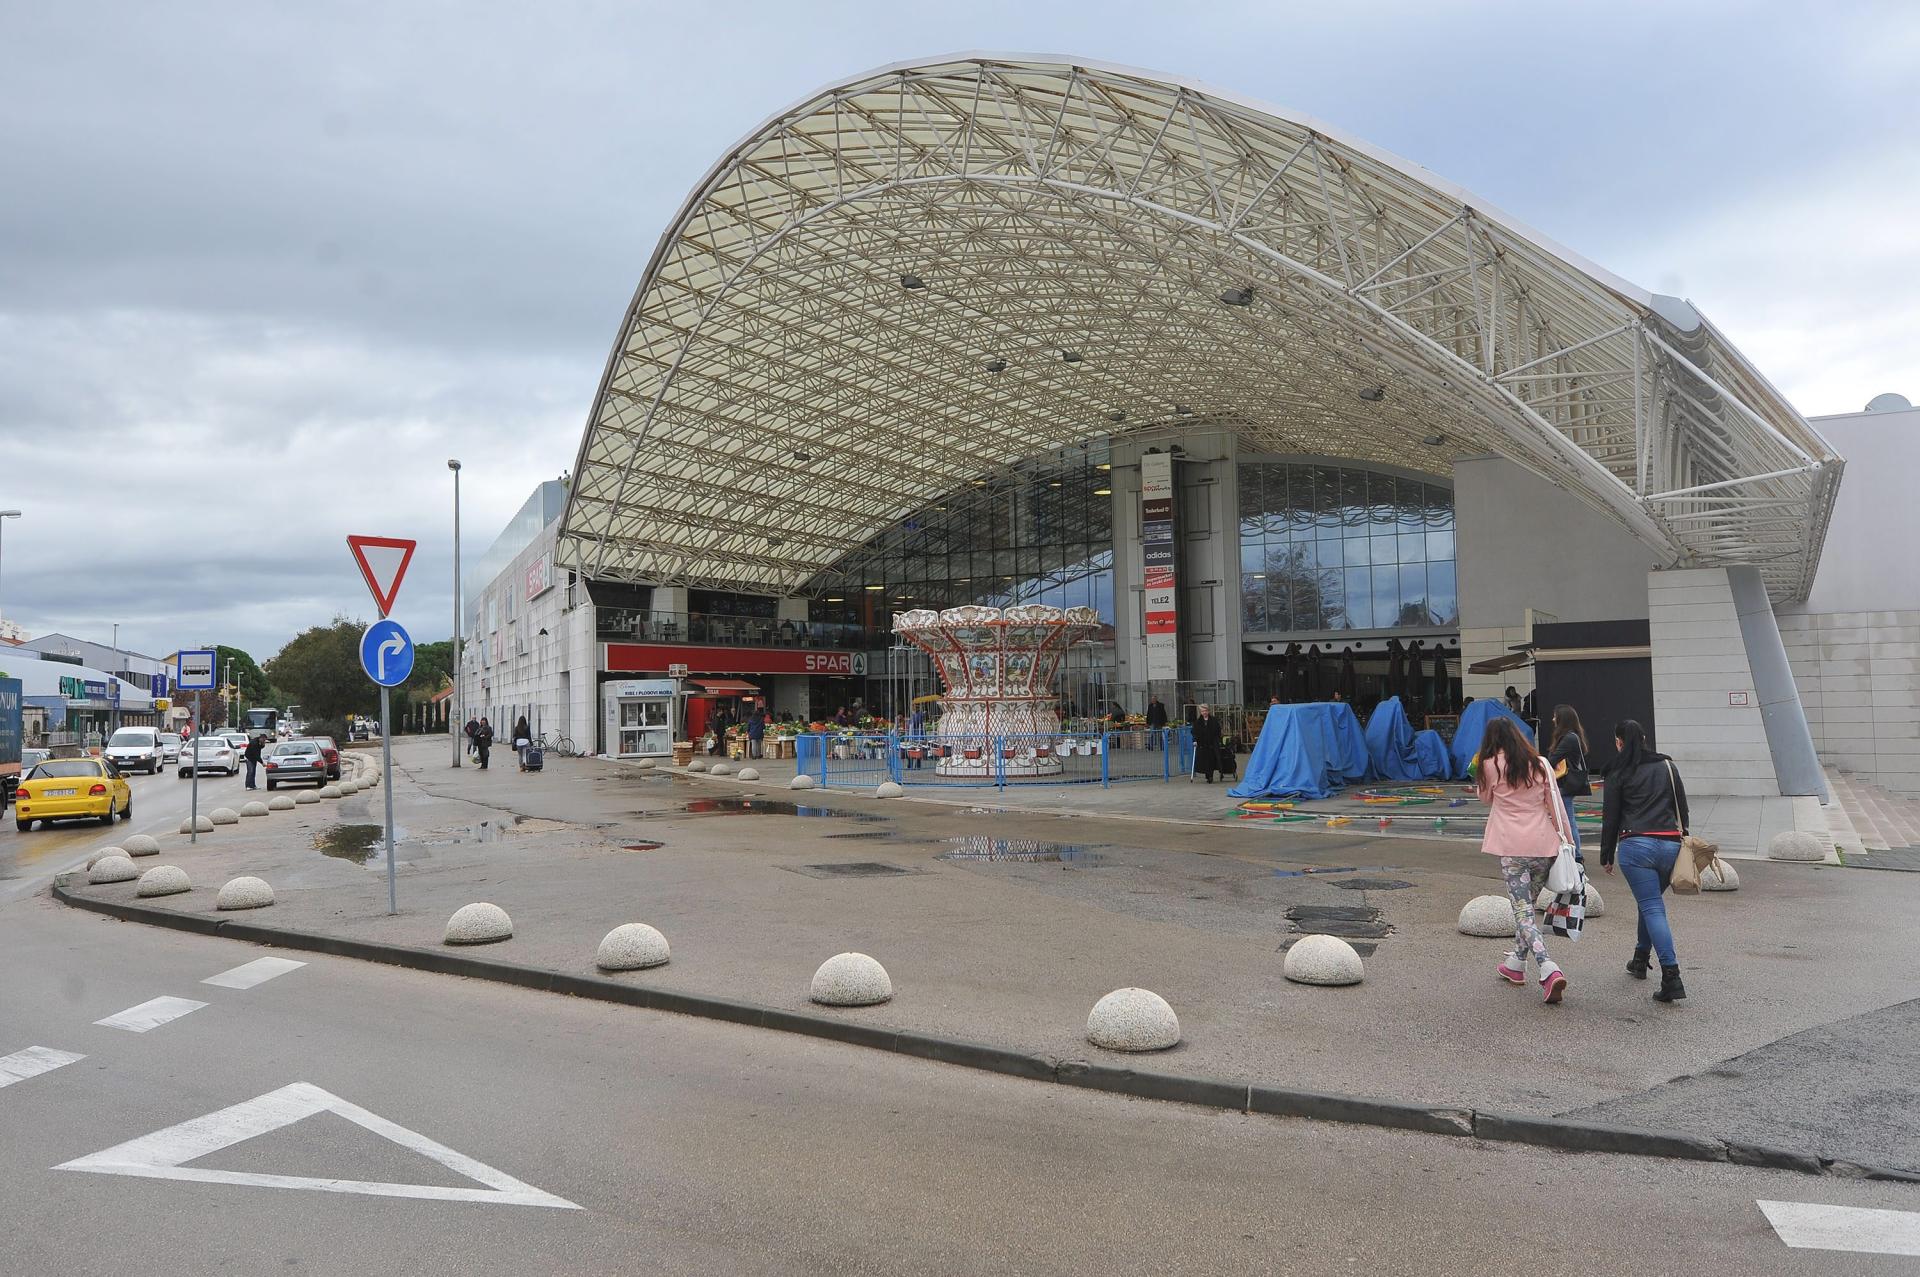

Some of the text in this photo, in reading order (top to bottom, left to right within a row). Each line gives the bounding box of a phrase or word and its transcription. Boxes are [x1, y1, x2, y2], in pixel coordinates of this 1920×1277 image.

[1146, 551, 1171, 560] adidas
[1151, 595, 1170, 605] TELE2
[805, 654, 850, 671] SPAR
